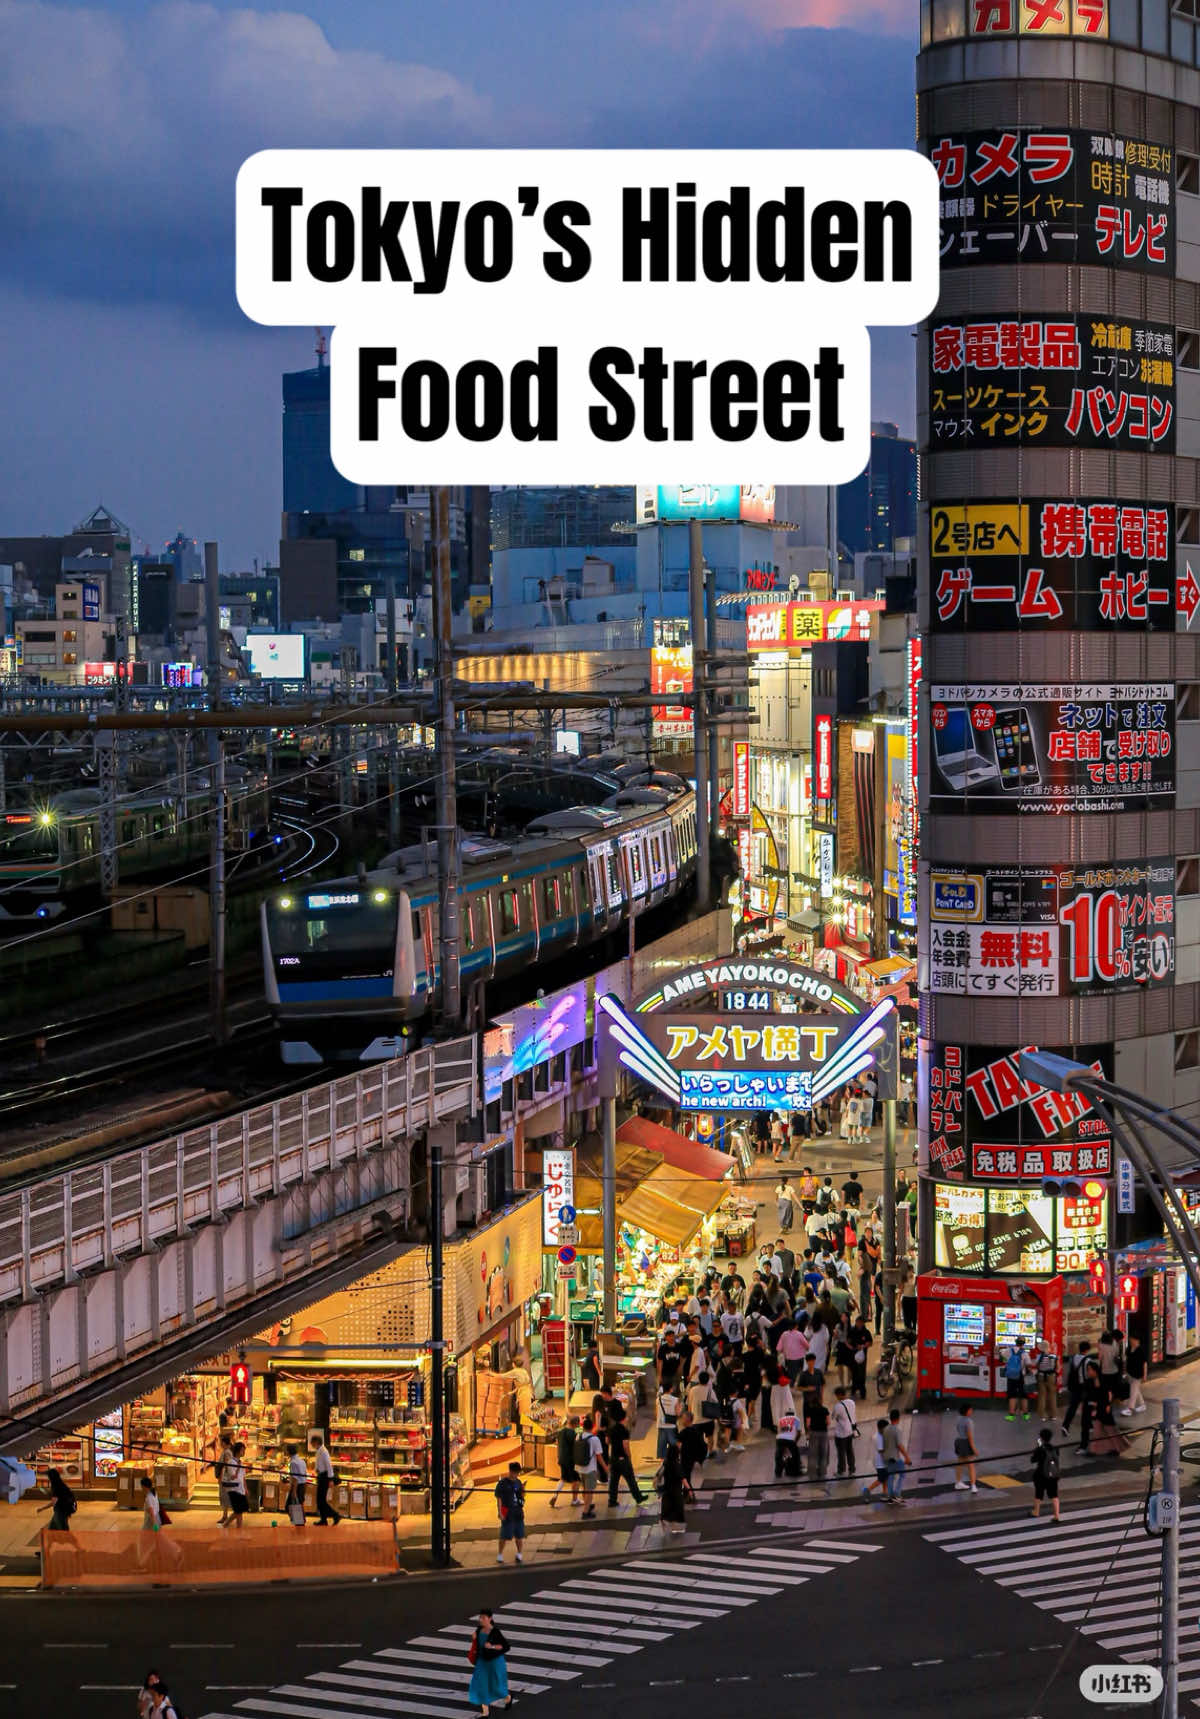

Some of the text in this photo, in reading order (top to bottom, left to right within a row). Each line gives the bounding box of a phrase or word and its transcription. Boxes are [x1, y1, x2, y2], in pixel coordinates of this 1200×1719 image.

[973, 0, 1104, 33] カメラ
[932, 133, 1073, 188] カメラ
[1125, 140, 1171, 173] 修理受付
[1091, 161, 1131, 198] 時計
[984, 192, 1083, 218] ドライヤー
[1095, 204, 1167, 263] テレビ
[933, 322, 1082, 372] 家電製品
[1092, 355, 1140, 380] エアコン
[932, 384, 1049, 412] スーツケース
[933, 418, 975, 438] マウス
[980, 411, 1049, 437] インク
[1064, 385, 1173, 442] パソコン
[934, 510, 1021, 554] 2号店へ
[1040, 503, 1168, 561] 携帯電話
[936, 568, 1063, 621] ゲーム
[1099, 568, 1169, 620] ホビー
[796, 612, 821, 638] 薬
[974, 708, 994, 718] スマホ
[976, 718, 992, 728] から
[1057, 703, 1167, 728] ネットで注文
[1048, 730, 1171, 761] 店舗で受け取り
[932, 929, 970, 948] 入会金
[980, 931, 1052, 968] 無料
[932, 949, 970, 968] 年会費
[662, 964, 833, 1002] AMEYAYOKOCHO
[932, 970, 1055, 991] 店頭にてすぐ発行
[666, 1025, 839, 1062] アメヤ横丁
[702, 1096, 729, 1107] new
[732, 1094, 767, 1107] arch!
[930, 1067, 943, 1132] カメラ
[944, 1046, 961, 1133] ヨドバシ
[929, 1135, 950, 1161] TAX
[940, 1146, 966, 1171] FREE
[976, 1146, 1108, 1172] 免税品取扱店
[1025, 1239, 1051, 1253] VISA
